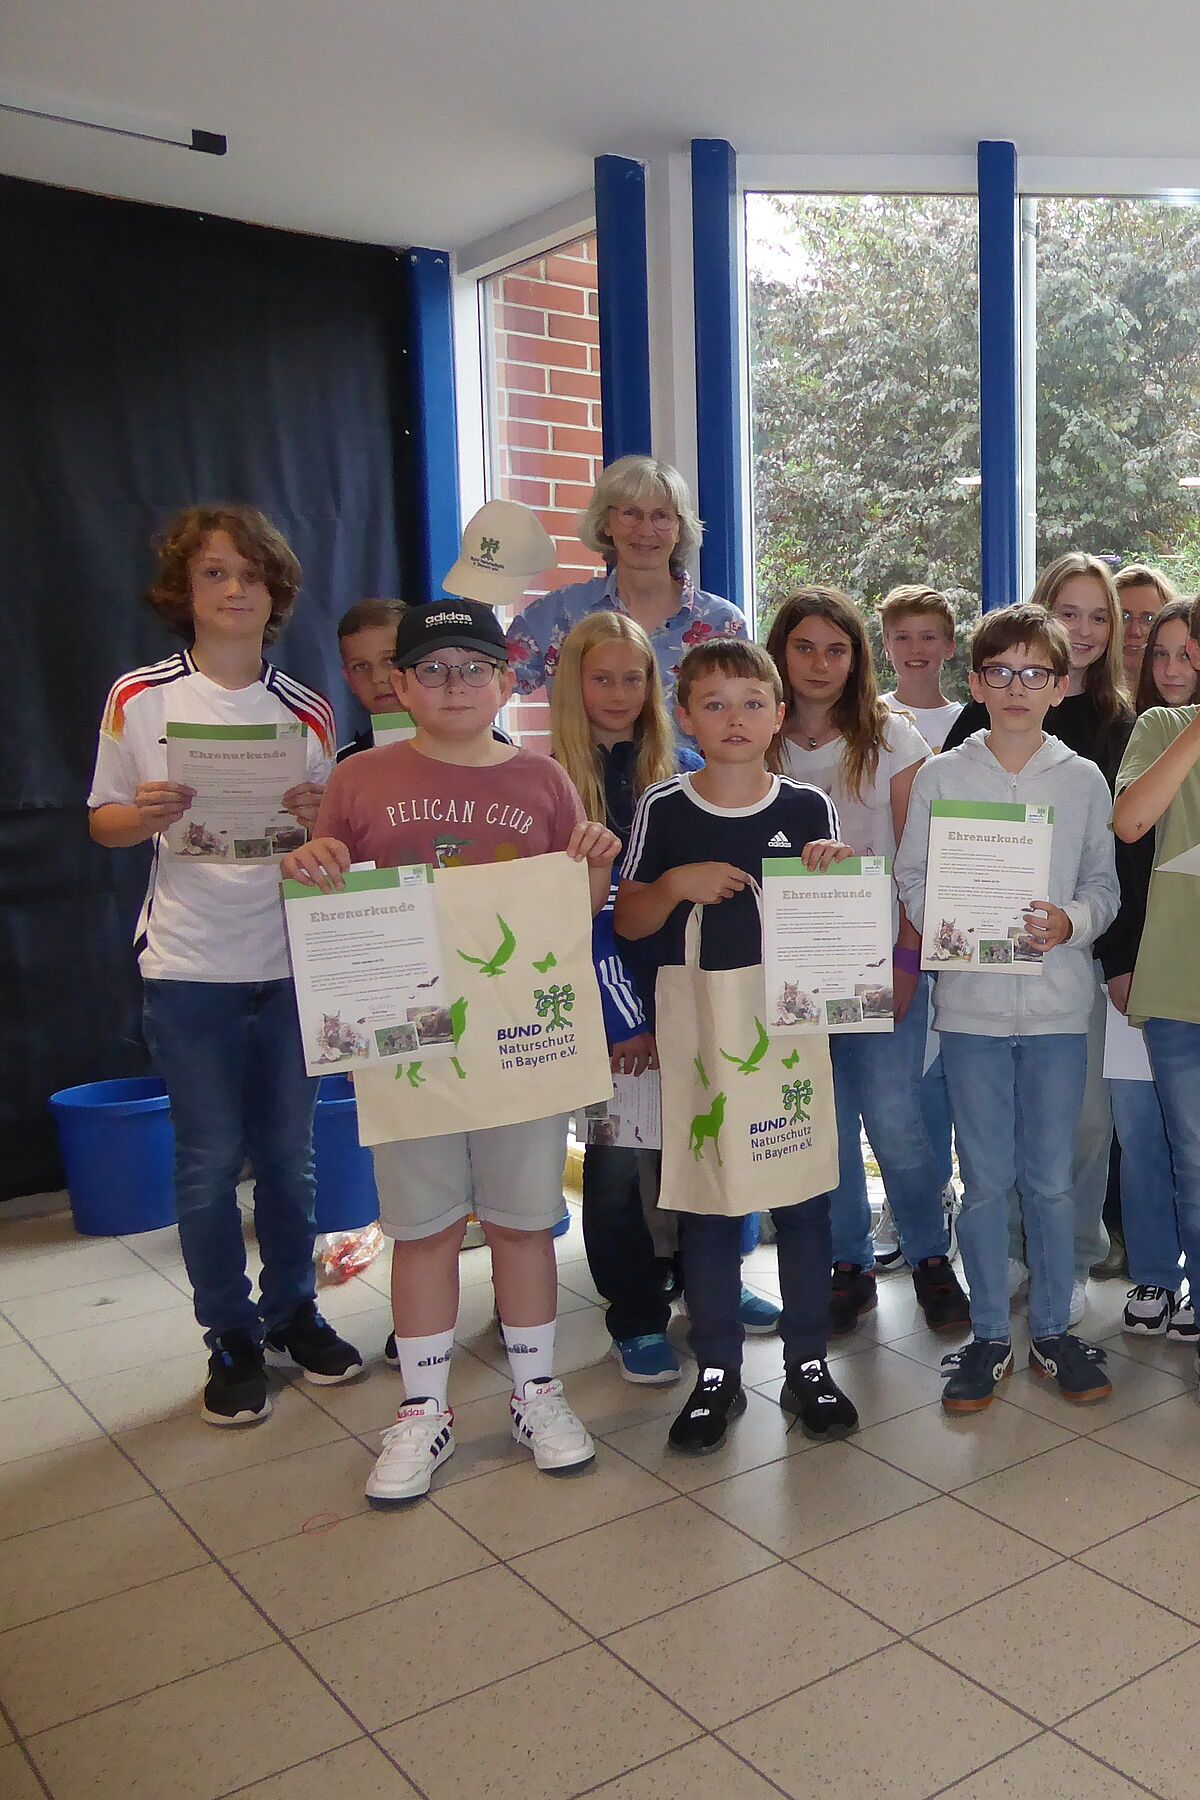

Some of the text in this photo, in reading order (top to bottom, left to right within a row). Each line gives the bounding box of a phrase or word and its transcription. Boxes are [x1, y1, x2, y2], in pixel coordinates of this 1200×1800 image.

[425, 611, 472, 624] adidas
[386, 798, 534, 834] PELICAN CLUB
[947, 831, 1034, 845] Ehrenurkunde
[782, 889, 873, 901] Ehrenurkunde
[309, 902, 416, 923] Ehrenurkunde
[497, 1024, 542, 1040] BUND
[499, 1034, 575, 1055] Naturschutz
[501, 1045, 577, 1069] in Bayern e.V.
[749, 1117, 787, 1135] BUND
[751, 1126, 812, 1149] Naturschutz
[752, 1137, 813, 1162] in Bayern e.V.
